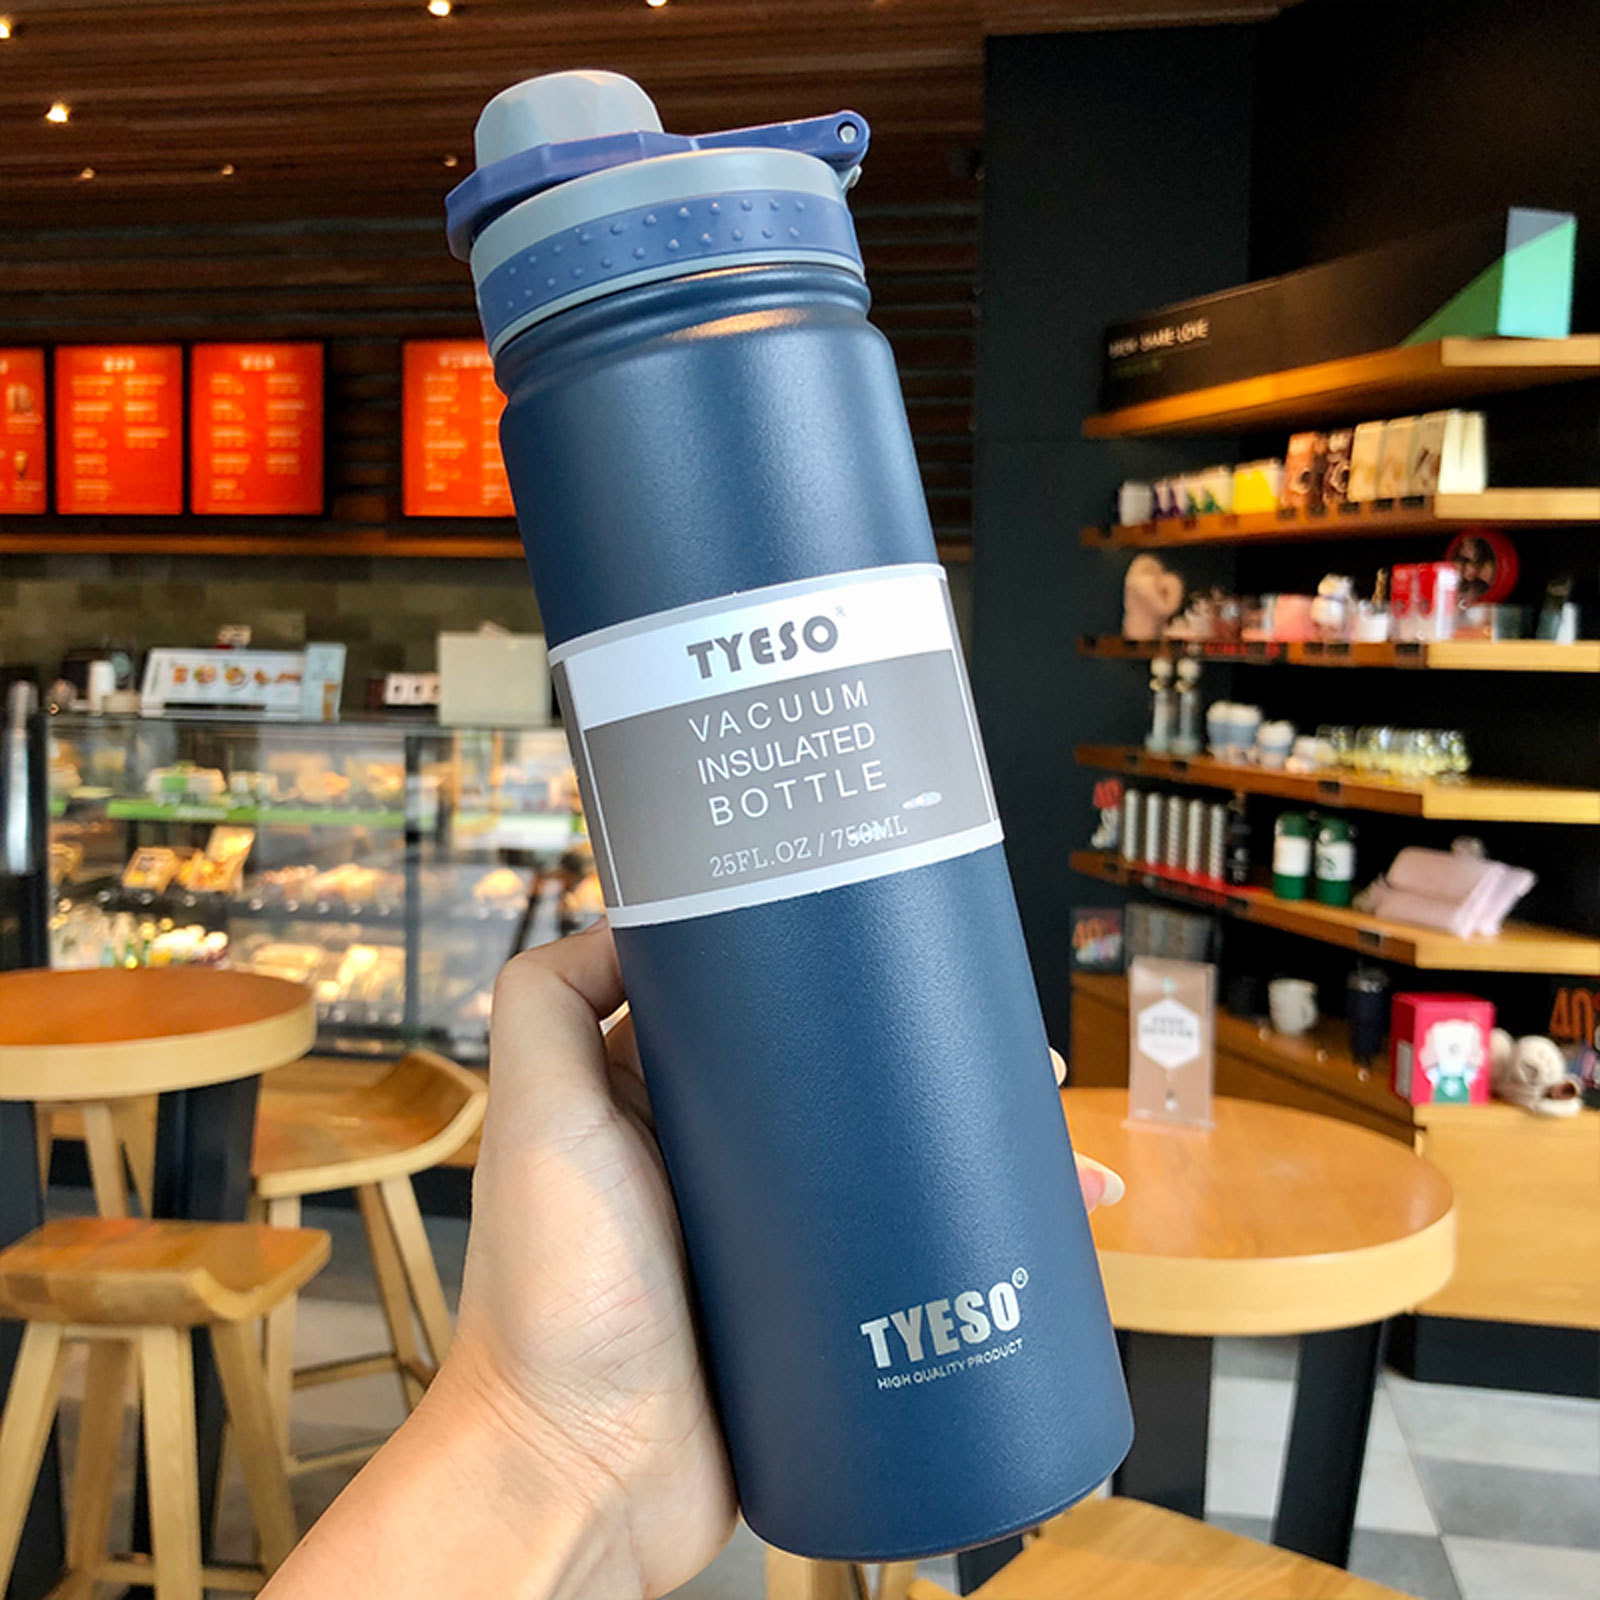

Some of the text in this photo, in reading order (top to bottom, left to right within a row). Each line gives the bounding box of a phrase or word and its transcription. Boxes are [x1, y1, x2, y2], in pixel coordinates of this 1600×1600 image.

[686, 615, 839, 680] TYESO
[689, 680, 870, 743] VACUUM
[697, 721, 876, 784] INSULATED
[709, 759, 887, 827] BOTTLE
[709, 836, 812, 878] 25FL.OZ
[830, 814, 909, 851] 750ML
[859, 1281, 1021, 1369] TYESO
[877, 1337, 1023, 1390] HIGH QUALITY PRODUCT
